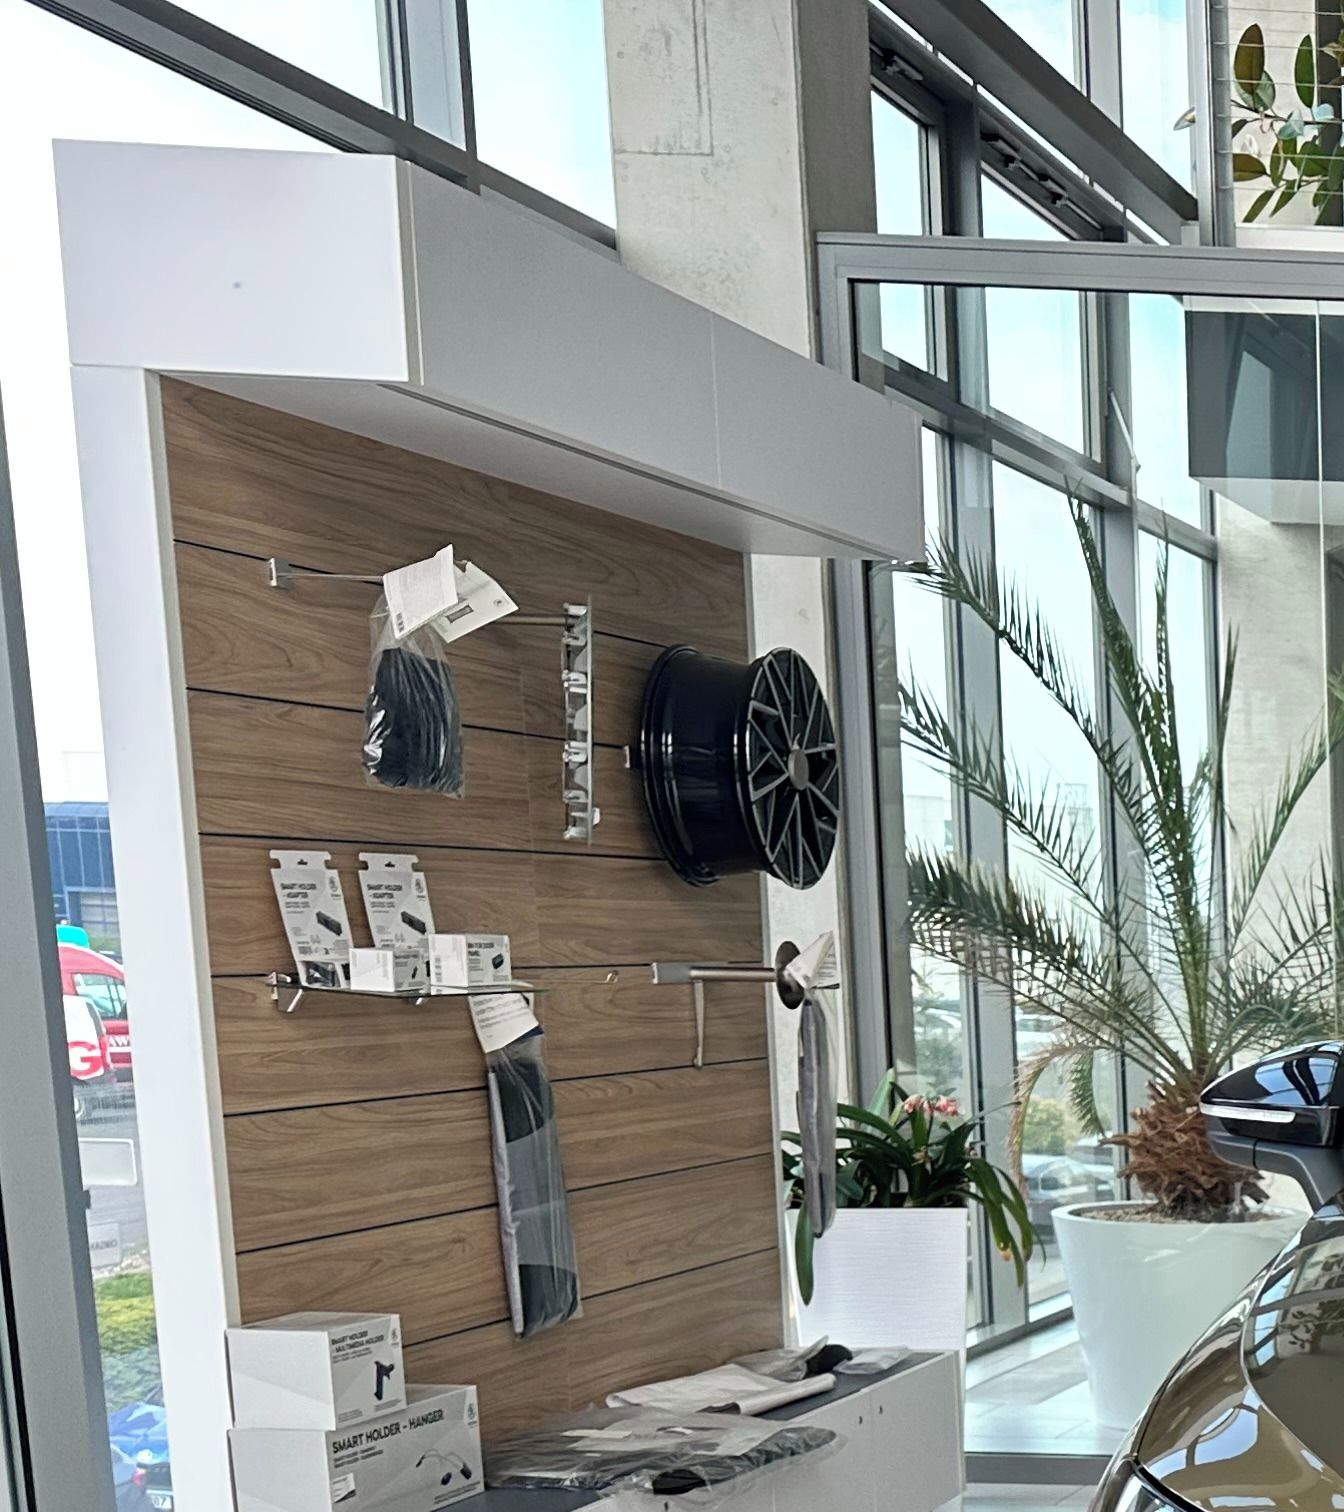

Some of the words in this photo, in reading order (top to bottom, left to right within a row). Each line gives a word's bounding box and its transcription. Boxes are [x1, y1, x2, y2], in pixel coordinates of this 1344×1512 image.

[349, 1330, 368, 1340] HOLDER
[365, 1334, 385, 1344] HOLDER
[332, 1433, 363, 1454] SMART
[365, 1422, 401, 1443] HOLDER
[408, 1408, 445, 1430] HANGER
